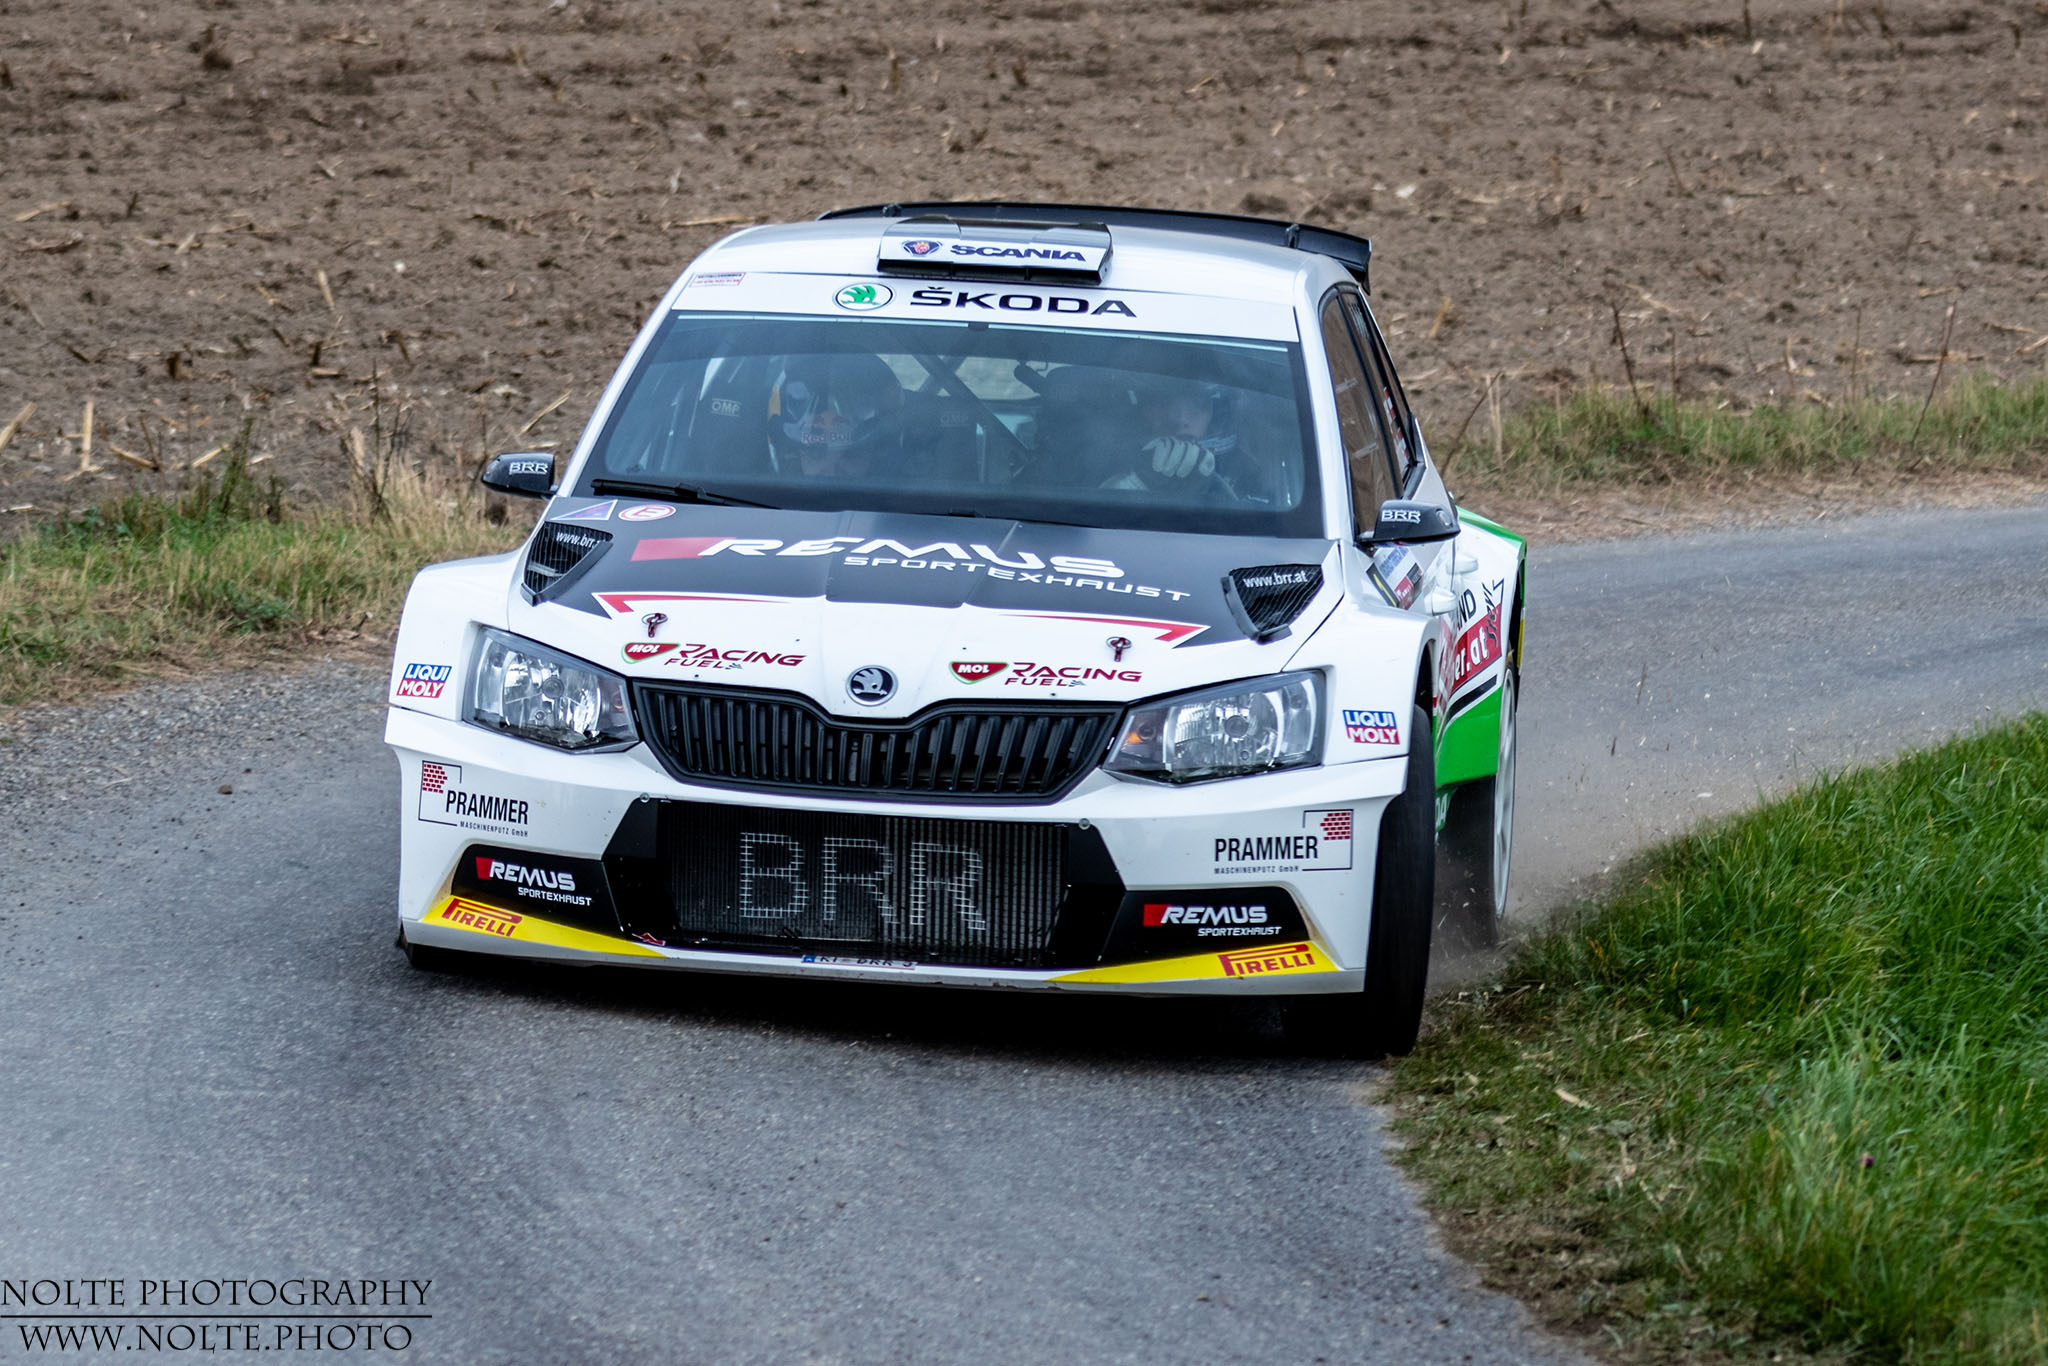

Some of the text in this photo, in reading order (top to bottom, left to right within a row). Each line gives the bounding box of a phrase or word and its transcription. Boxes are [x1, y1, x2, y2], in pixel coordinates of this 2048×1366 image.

[950, 244, 1087, 262] SCANIA
[910, 286, 1137, 318] ŠKODA
[711, 400, 741, 416] OMP
[509, 462, 548, 475] BRR
[1381, 509, 1421, 524] BRR
[697, 537, 1125, 579] REMUS
[843, 556, 1191, 602] SPORTEXHAUST
[1242, 570, 1308, 588] www.brr.at
[627, 643, 807, 667] MOL RACING
[664, 658, 726, 669] FUEL
[404, 665, 450, 683] LIQUI
[957, 662, 1142, 682] MOL RACING
[399, 682, 443, 697] MOLY
[1004, 678, 1068, 686] FUEL
[1346, 710, 1396, 727] LIQUI
[1349, 727, 1399, 744] MOLY
[445, 790, 529, 825] PRAMMER
[460, 821, 529, 838] MASCHINENPUTZ GmbH
[1214, 836, 1318, 862] PRAMMER
[489, 861, 576, 892] REMUS
[1214, 865, 1299, 875] MASCHINENPUTZ GmbH
[739, 832, 986, 930] BRR
[517, 887, 593, 906] SPORTEXHAUST
[441, 898, 523, 937] PIRELLI
[1160, 905, 1268, 926] REMUS
[1197, 926, 1282, 937] SPORTEXHAUST
[1217, 943, 1315, 977] PIRELLI
